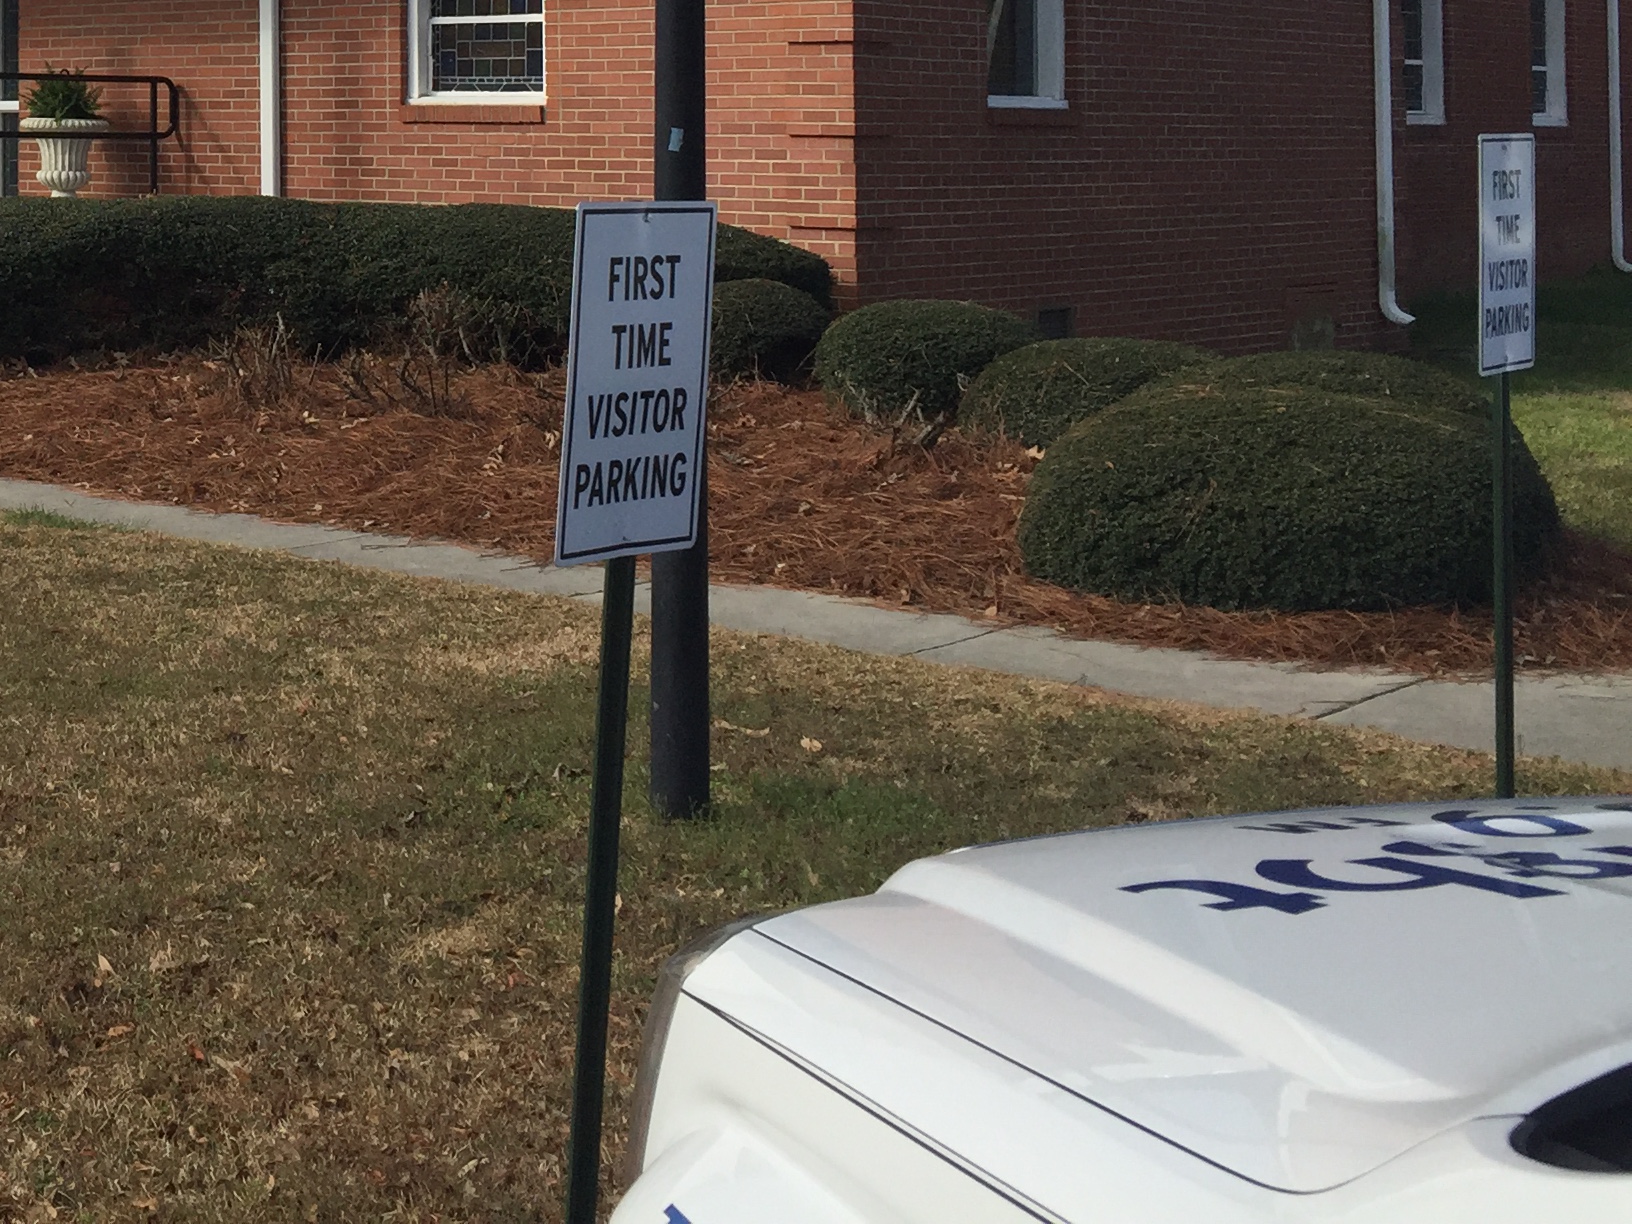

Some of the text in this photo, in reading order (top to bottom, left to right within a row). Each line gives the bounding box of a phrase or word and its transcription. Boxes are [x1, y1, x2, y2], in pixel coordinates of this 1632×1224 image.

[1492, 169, 1522, 201] FIRST
[1495, 214, 1521, 246] TIME
[608, 254, 681, 302] FIRST
[1487, 258, 1529, 292] VISITOR
[1485, 302, 1530, 340] PARKING
[611, 321, 673, 370] TIME
[587, 387, 688, 440] VISITOR
[572, 452, 687, 510] PARKING
